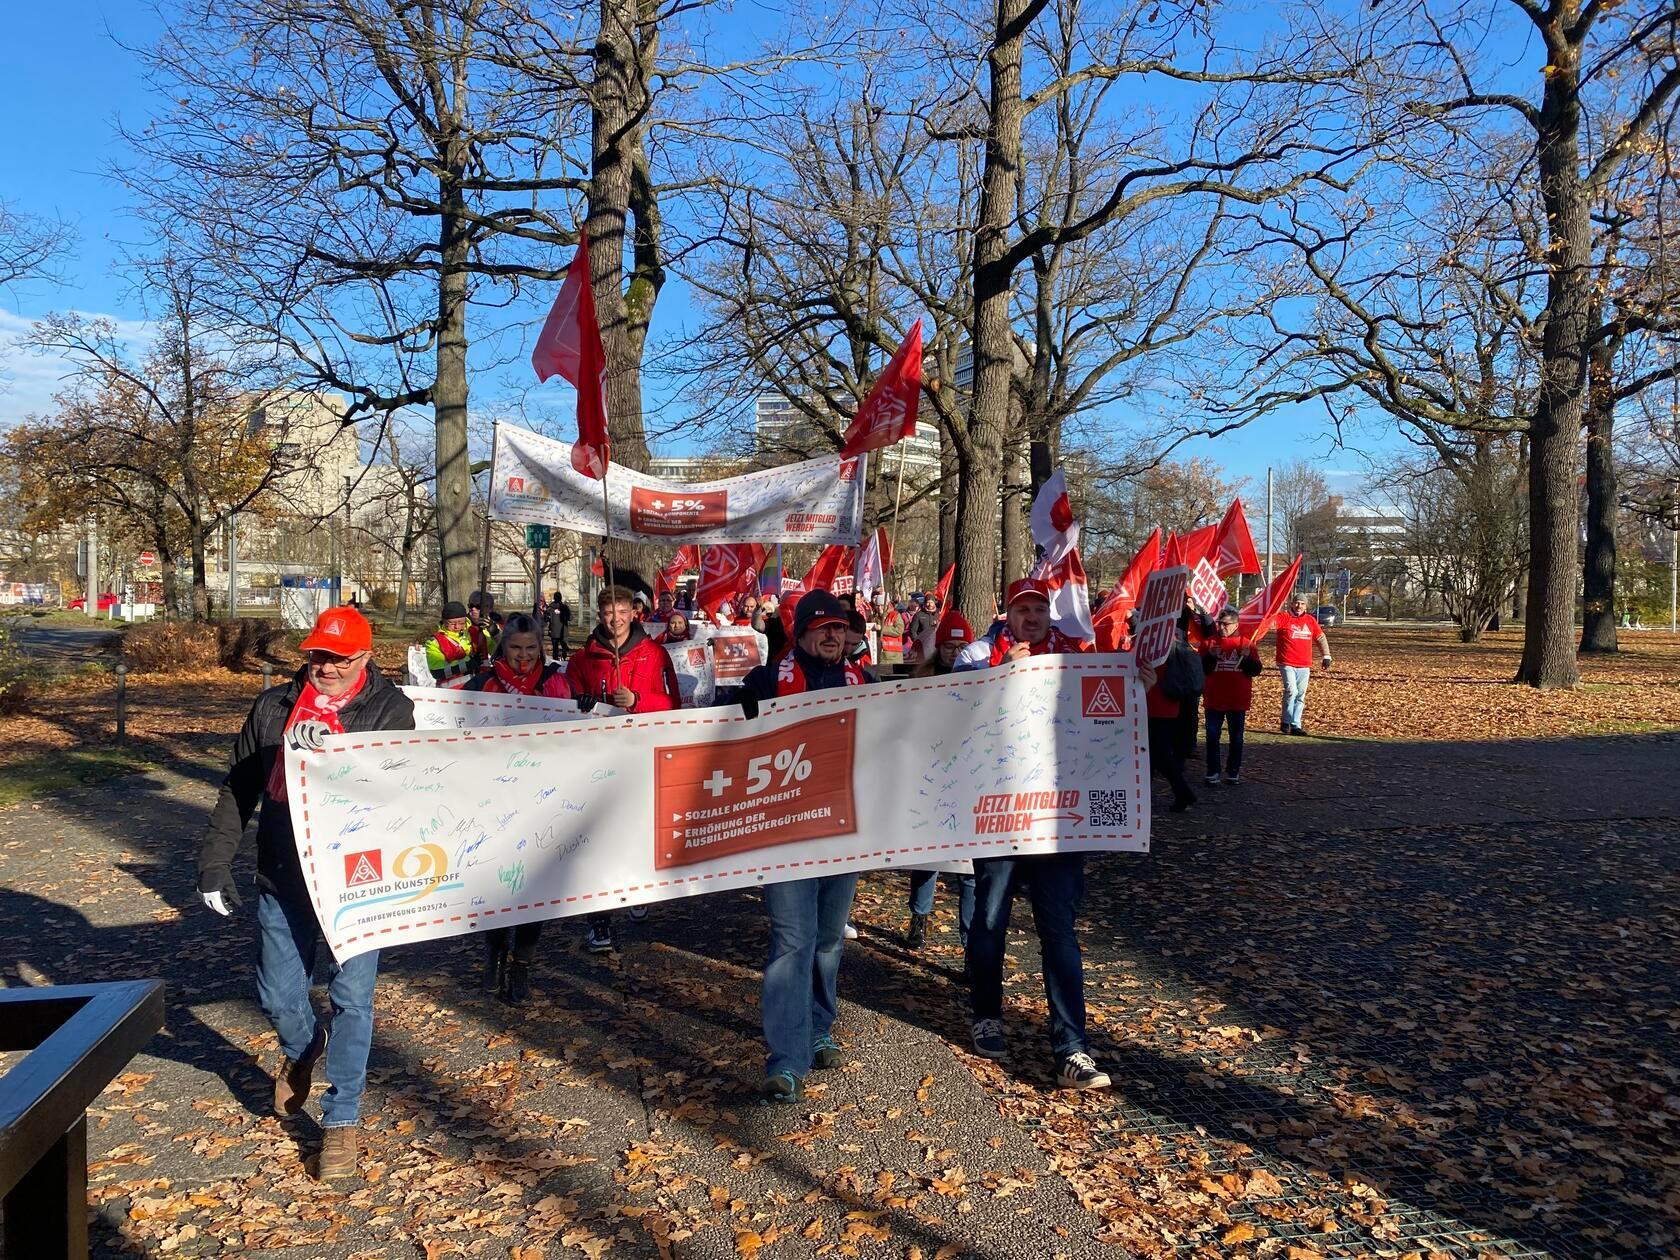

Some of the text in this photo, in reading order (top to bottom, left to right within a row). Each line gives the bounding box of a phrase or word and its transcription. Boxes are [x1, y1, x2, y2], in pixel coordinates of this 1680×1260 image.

[651, 500, 706, 511] + 5%
[785, 513, 837, 524] JETZT MITGLIED
[784, 523, 815, 532] WERDEN
[782, 580, 801, 591] MEH
[1140, 572, 1187, 623] MEHR
[1197, 562, 1228, 610] MEHR
[732, 643, 749, 657] 5%
[1135, 617, 1175, 667] GELD
[703, 742, 813, 797] + 5%
[685, 787, 801, 822] SOZIALE KOMPONENTE
[973, 790, 1081, 815] JETZT MITGLIED
[684, 806, 832, 849] AUSBILDUNGSVERGÜTUNGEN
[685, 812, 766, 839] ERHÖHUNG DER
[975, 812, 1033, 835] WERDEN
[555, 834, 590, 861] Dustin
[339, 872, 460, 904] HOLZ UND KUNSTSTOFF
[357, 902, 448, 926] TARIFBEWEGUNG 2025/26
